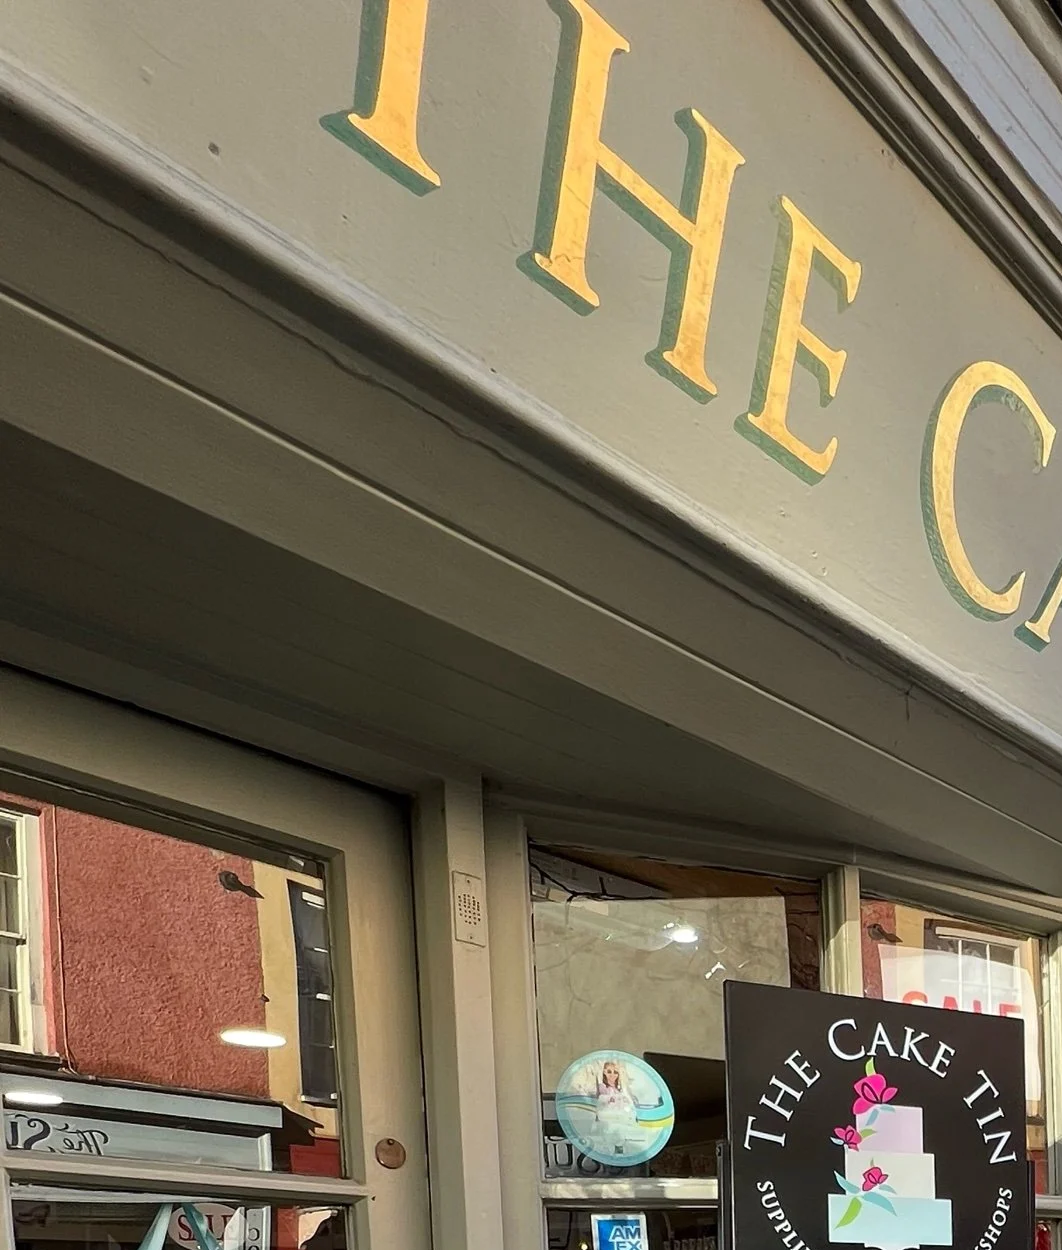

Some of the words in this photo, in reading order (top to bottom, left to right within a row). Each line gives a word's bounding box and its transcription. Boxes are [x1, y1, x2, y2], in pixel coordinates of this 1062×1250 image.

[743, 1049, 822, 1150] THE
[827, 1018, 956, 1079] CAKE
[963, 1069, 1018, 1165] TIN
[610, 1225, 641, 1241] AM
